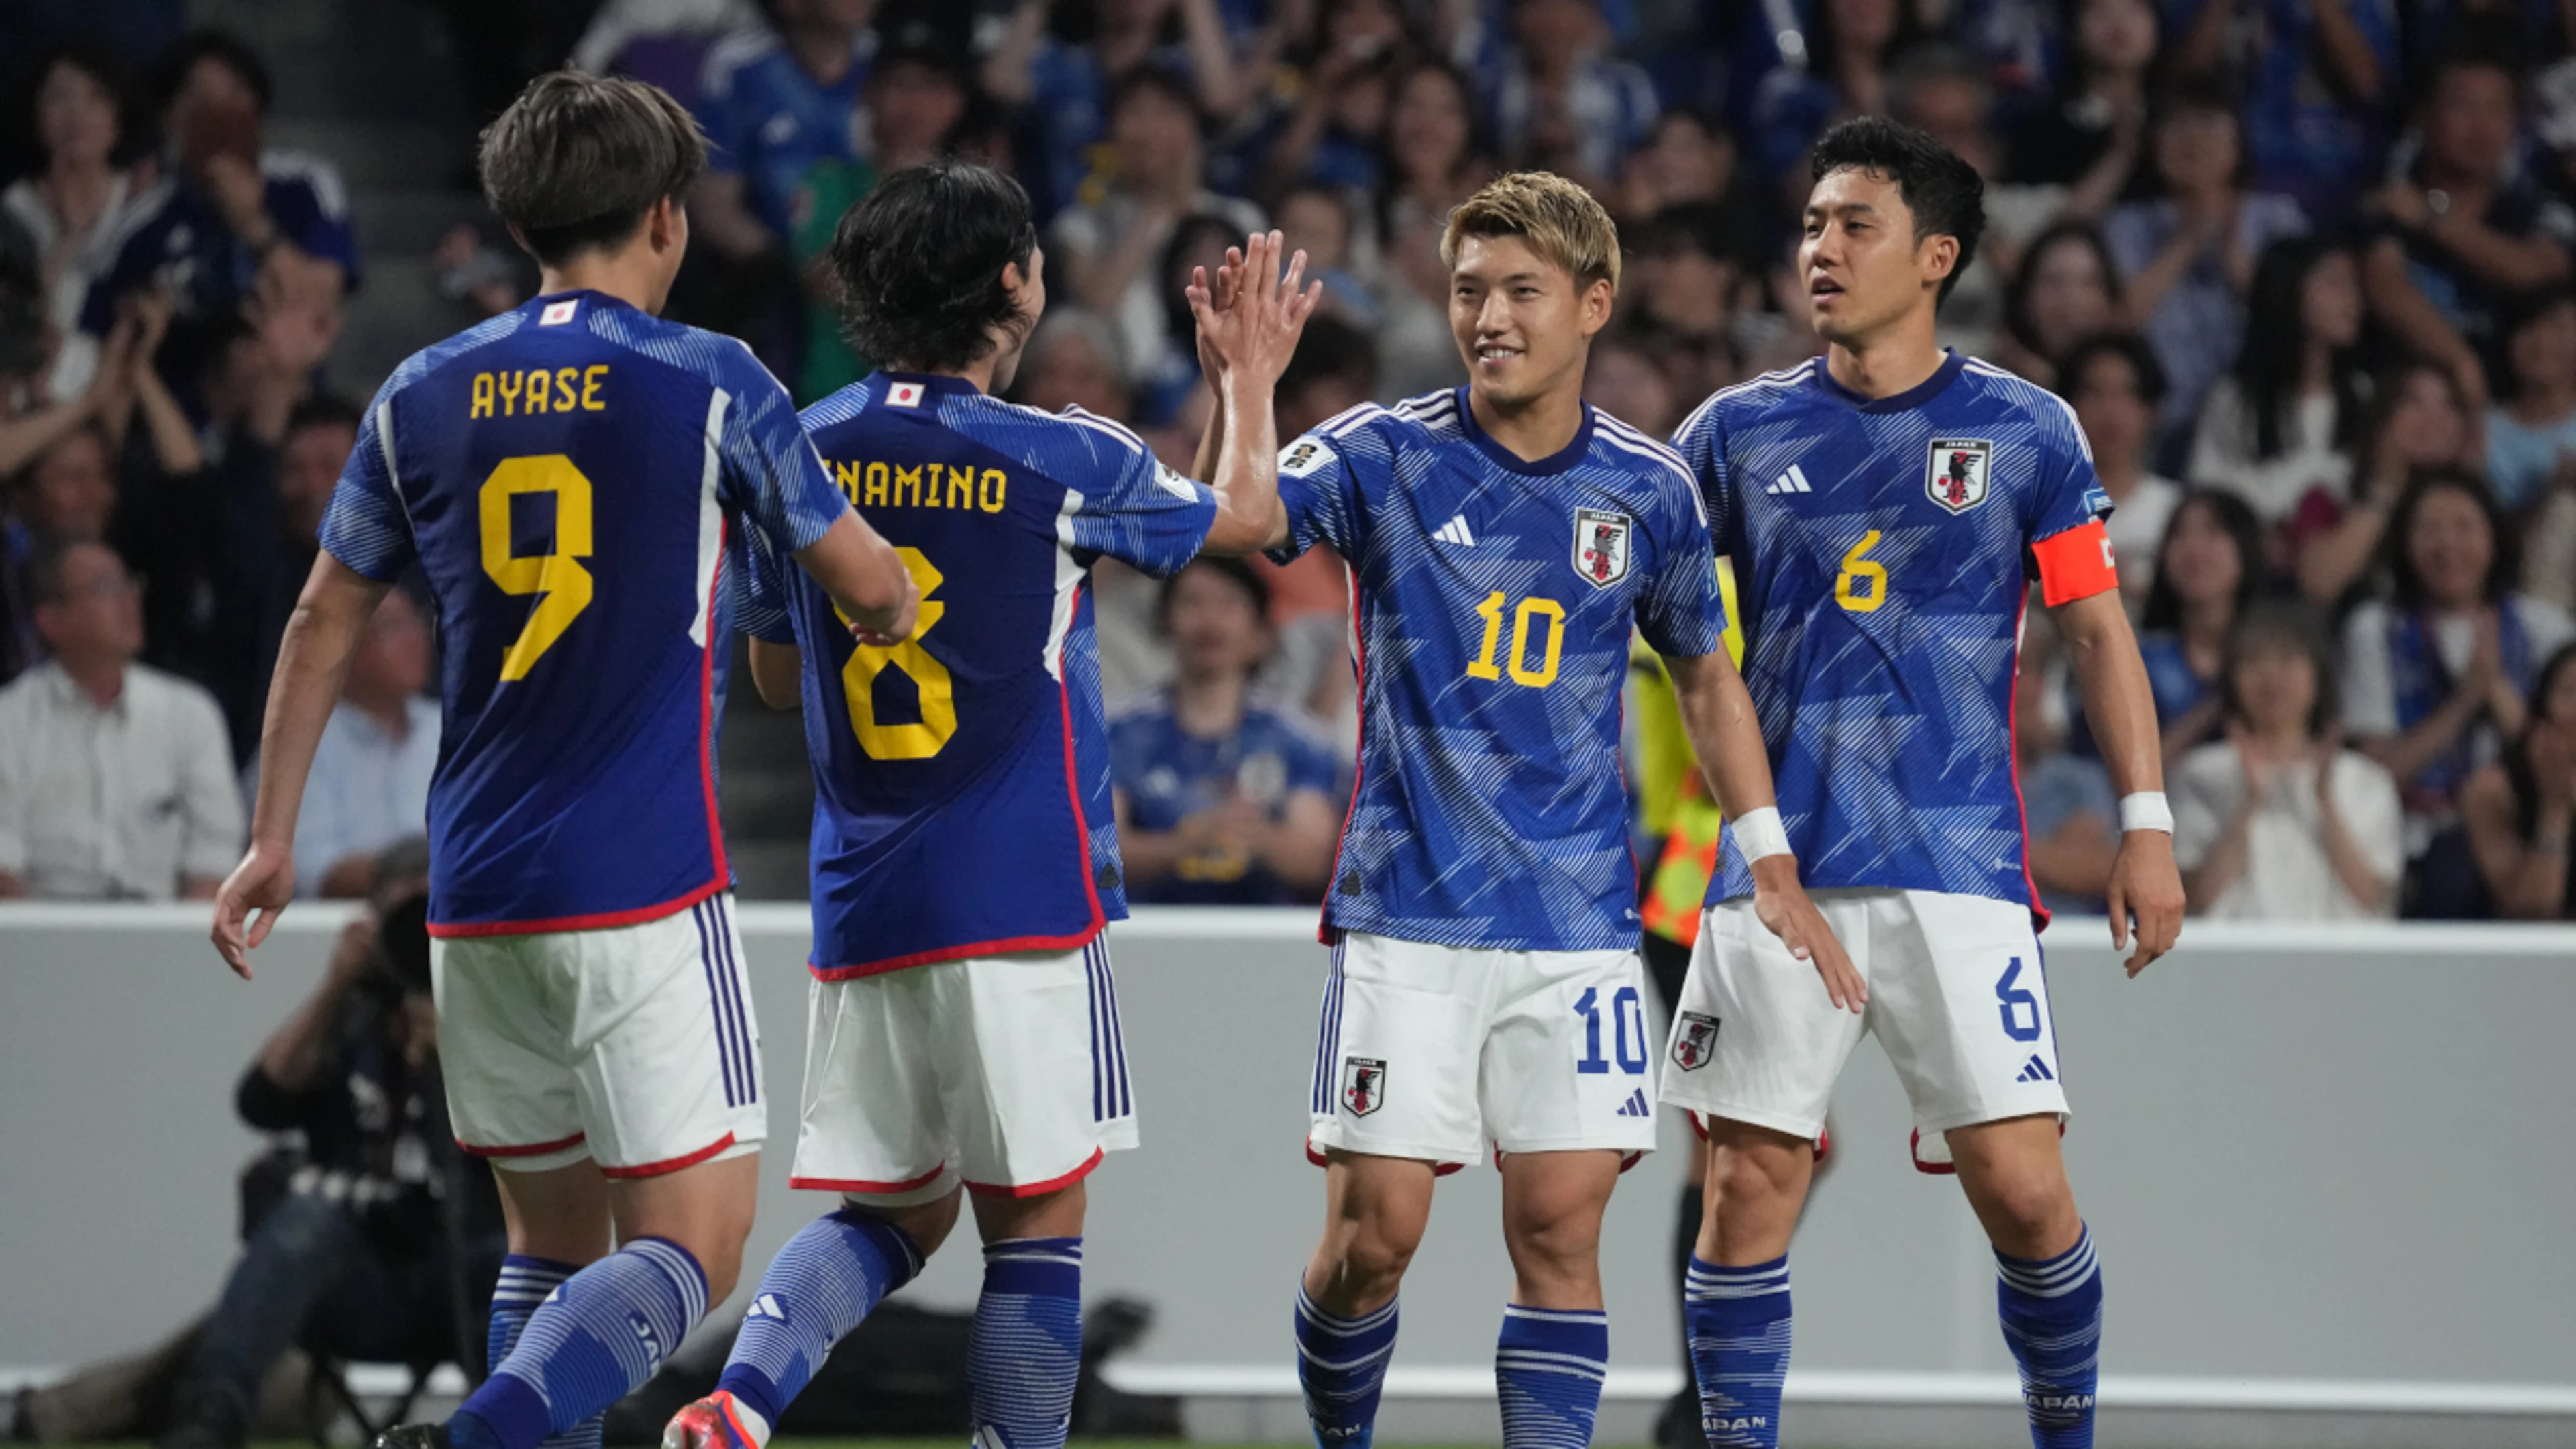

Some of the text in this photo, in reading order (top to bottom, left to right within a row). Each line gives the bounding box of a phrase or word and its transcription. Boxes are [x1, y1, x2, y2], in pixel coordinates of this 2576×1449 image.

[470, 364, 609, 419] AYASE
[823, 459, 1007, 514] NAMINO
[479, 454, 593, 682] 9
[1835, 529, 1888, 612] 6
[833, 547, 957, 760] 8
[1466, 591, 1566, 688] 10
[1574, 987, 1648, 1075] 10
[1996, 957, 2041, 1042] 6
[2024, 1395, 2094, 1409] APAN
